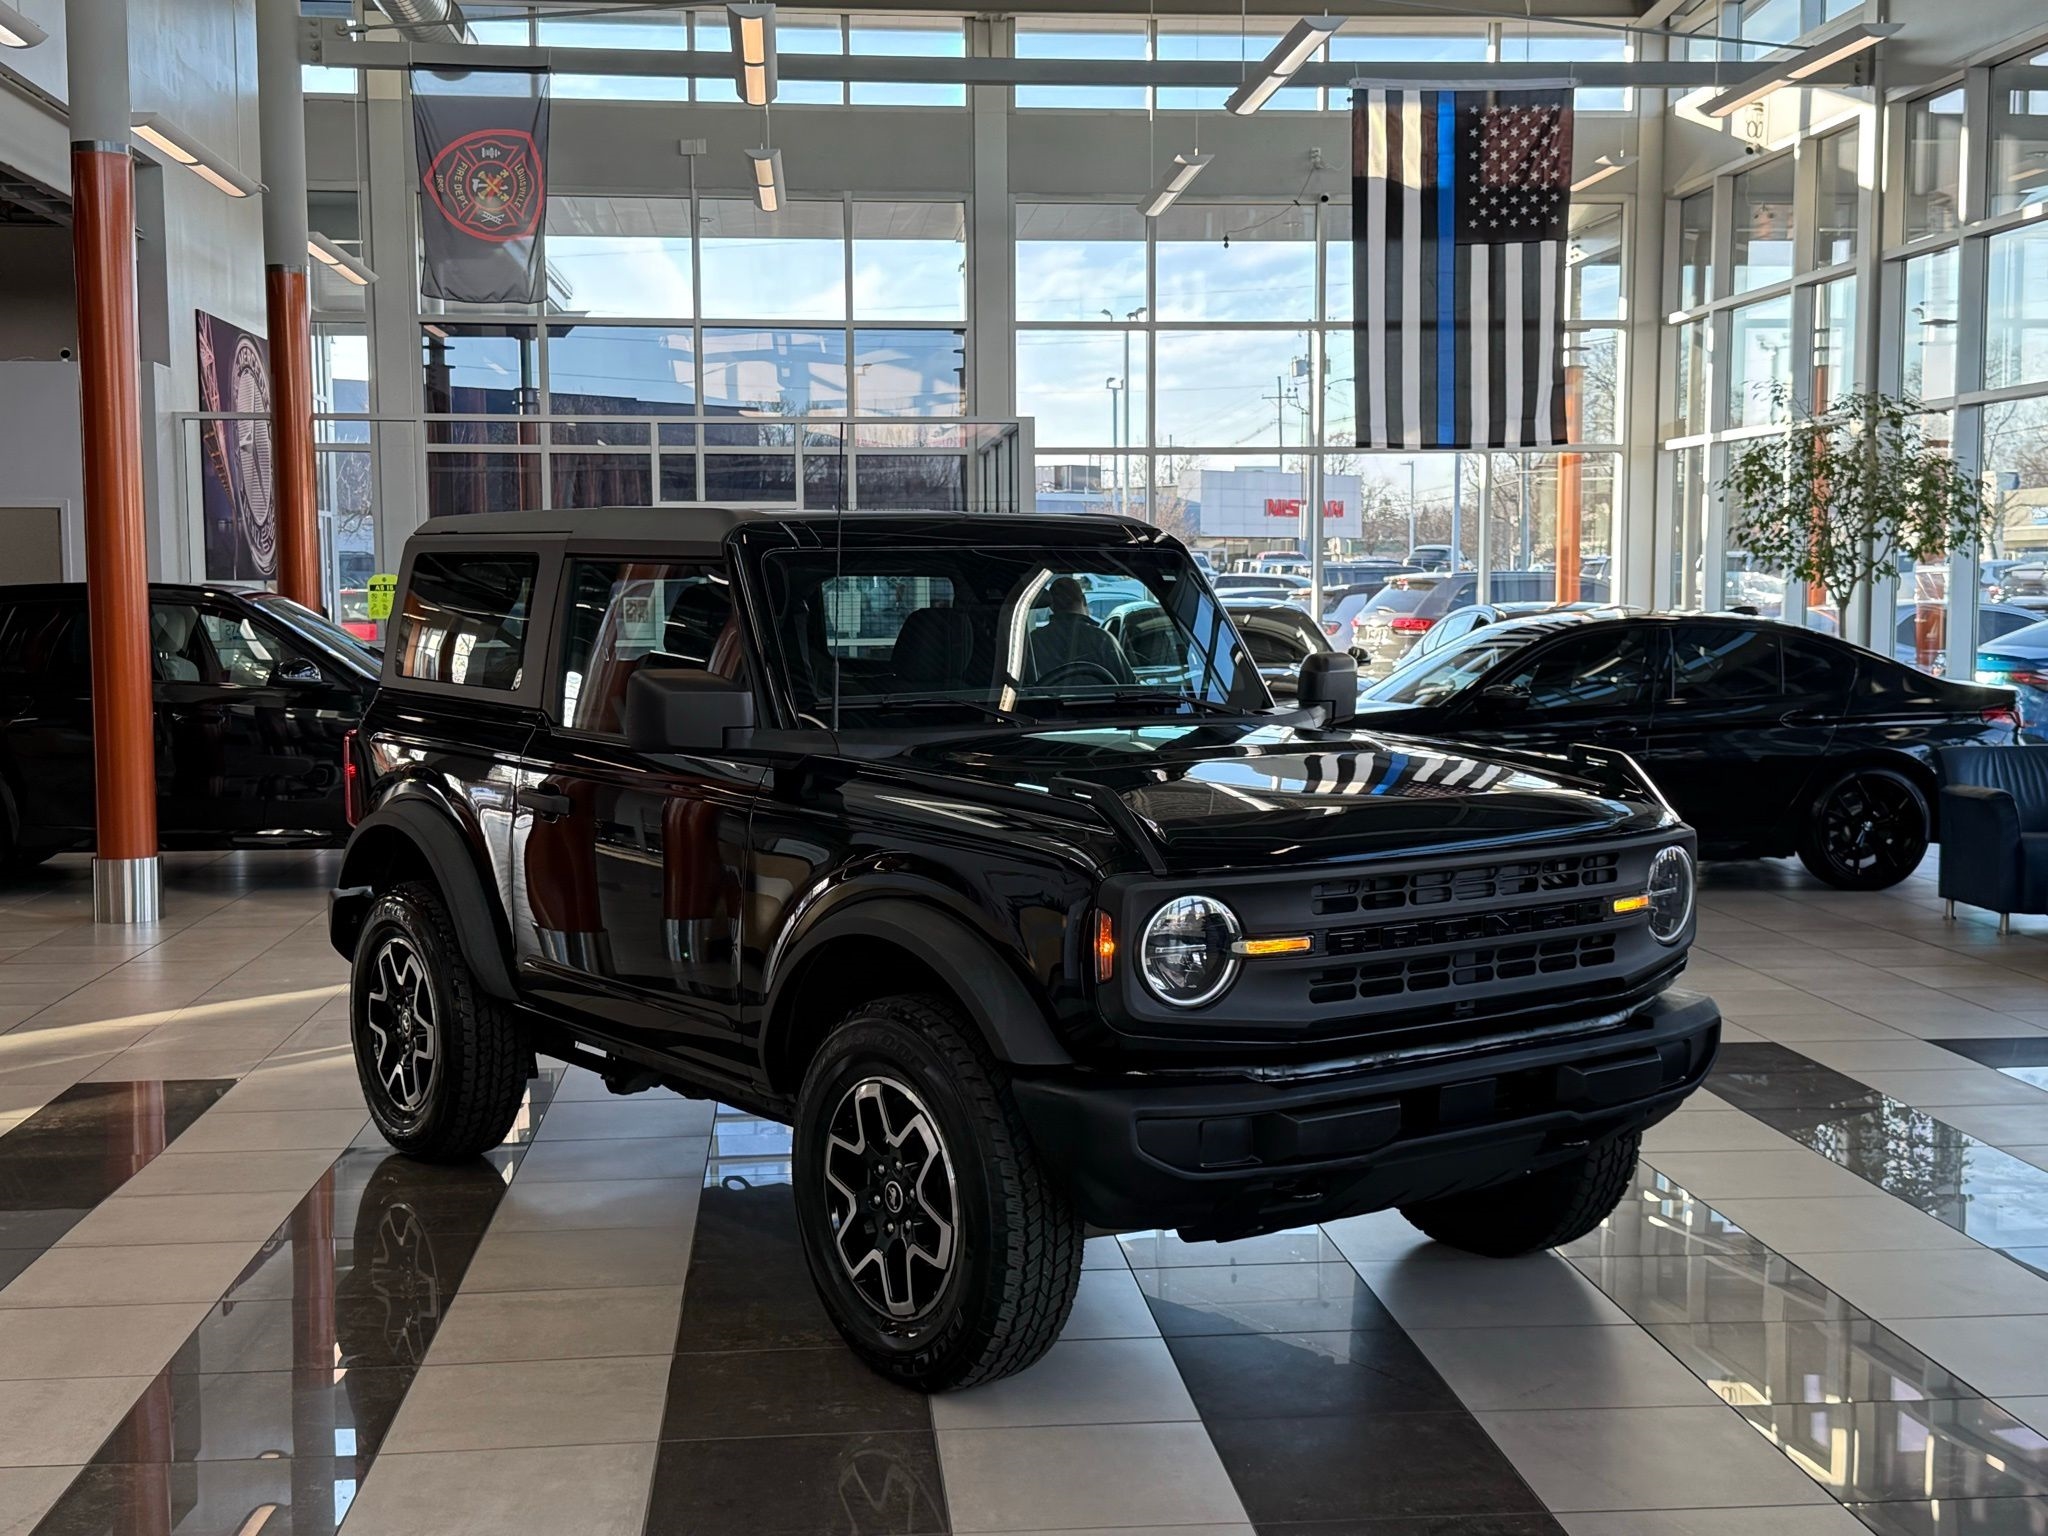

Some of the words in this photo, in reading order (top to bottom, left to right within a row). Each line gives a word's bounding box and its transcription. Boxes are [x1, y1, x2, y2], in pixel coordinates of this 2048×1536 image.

[454, 161, 468, 181] FIRE
[514, 163, 527, 208] LOUISVILLE
[1264, 499, 1344, 518] NISN
